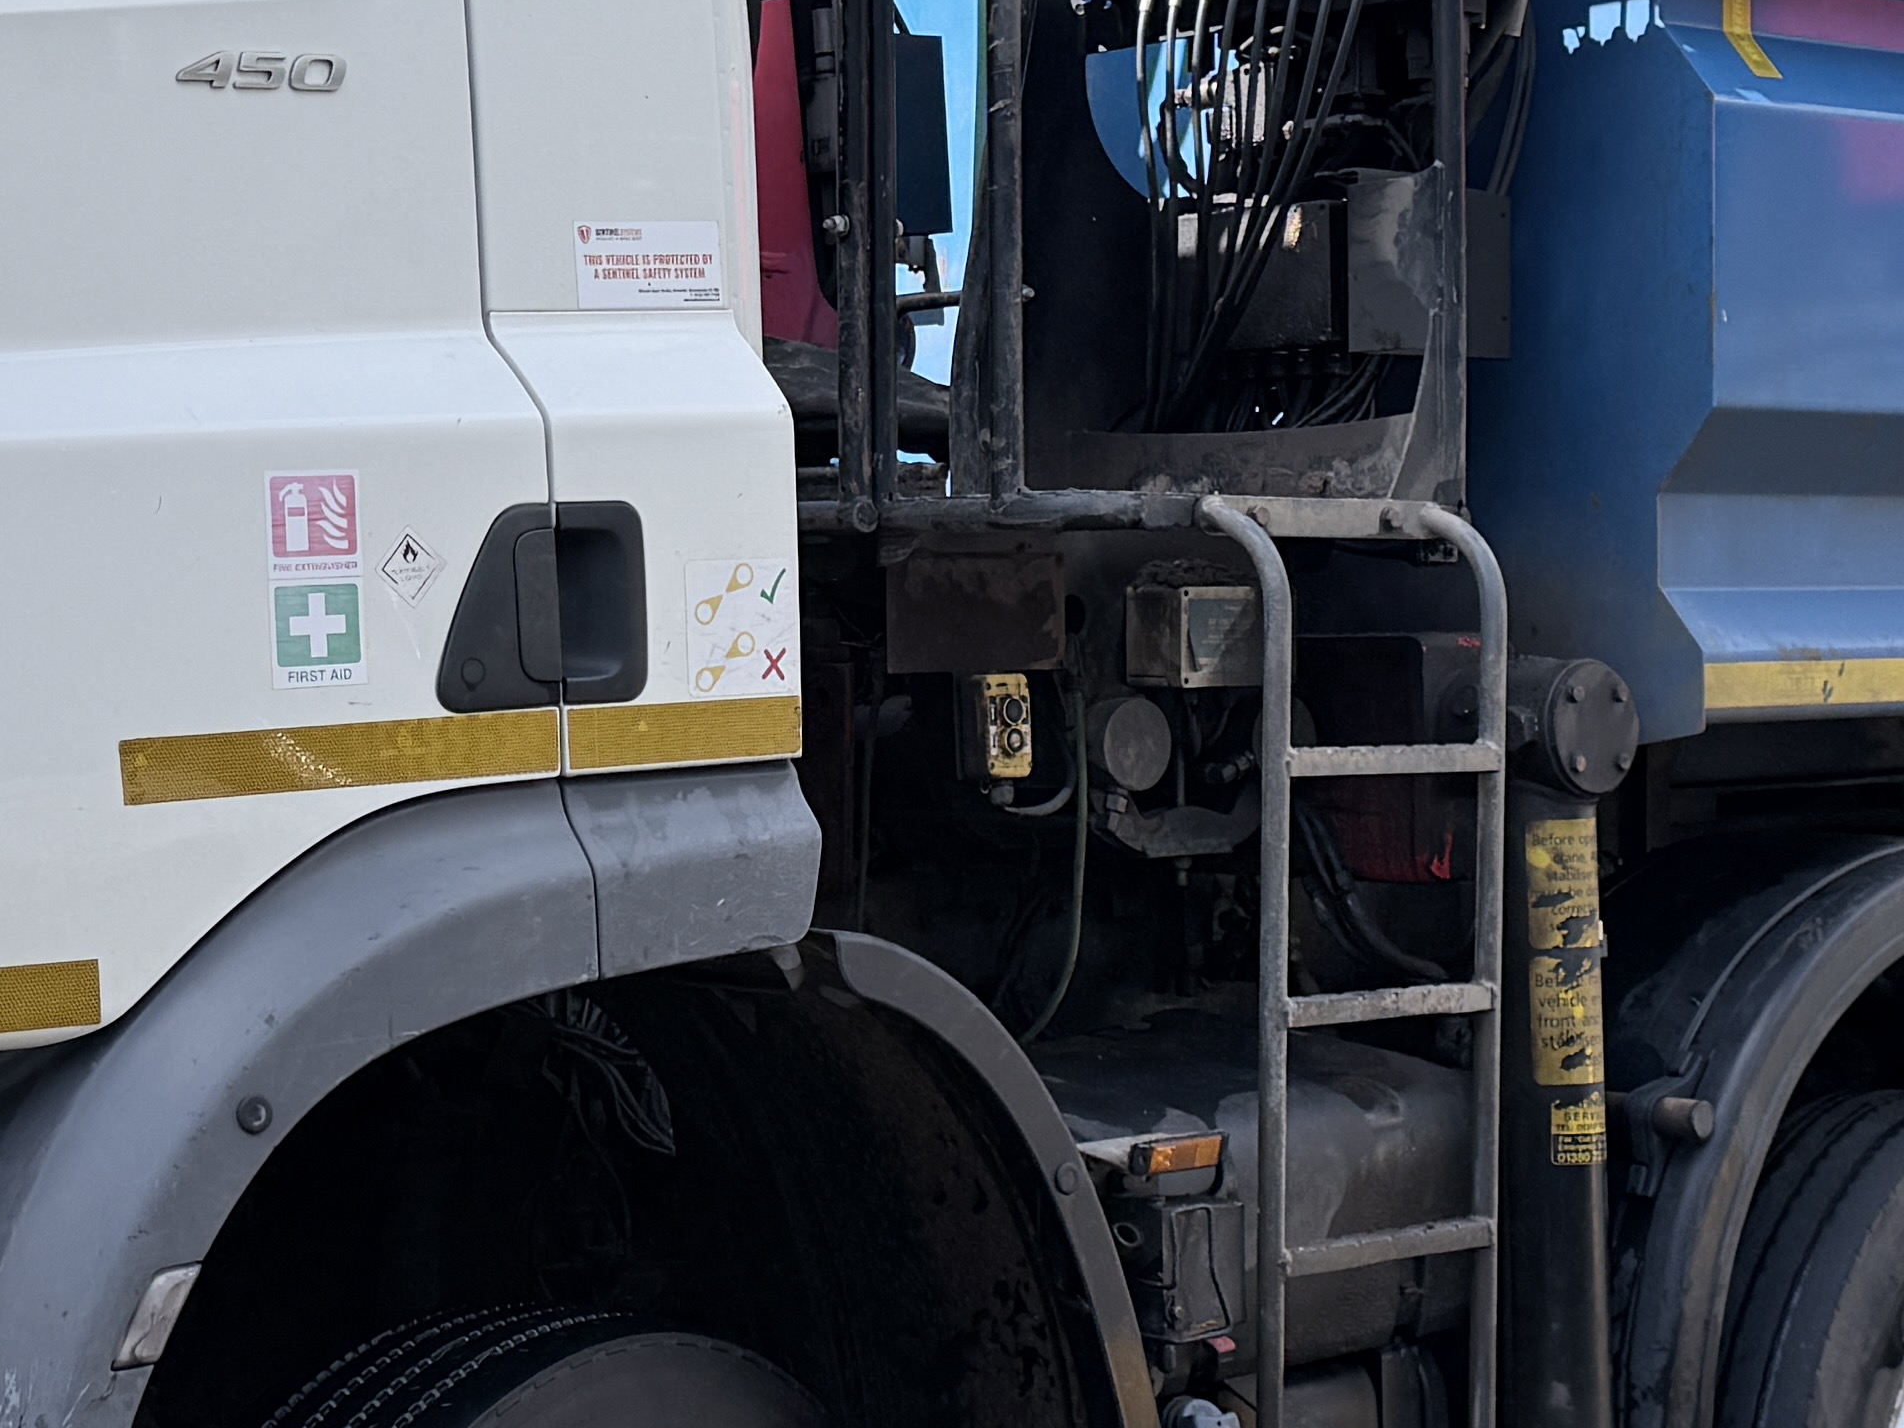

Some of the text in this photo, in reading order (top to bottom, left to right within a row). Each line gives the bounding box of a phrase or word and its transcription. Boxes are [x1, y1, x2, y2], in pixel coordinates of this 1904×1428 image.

[176, 50, 348, 92] 450
[583, 254, 603, 266] THIS
[605, 254, 641, 266] VEHICLE
[642, 254, 651, 266] IS
[653, 254, 700, 265] PROTECTED
[288, 668, 353, 684] FIRST AID
[1531, 833, 1575, 846] Before
[1538, 993, 1587, 1009] vehicle
[1538, 1014, 1576, 1029] front
